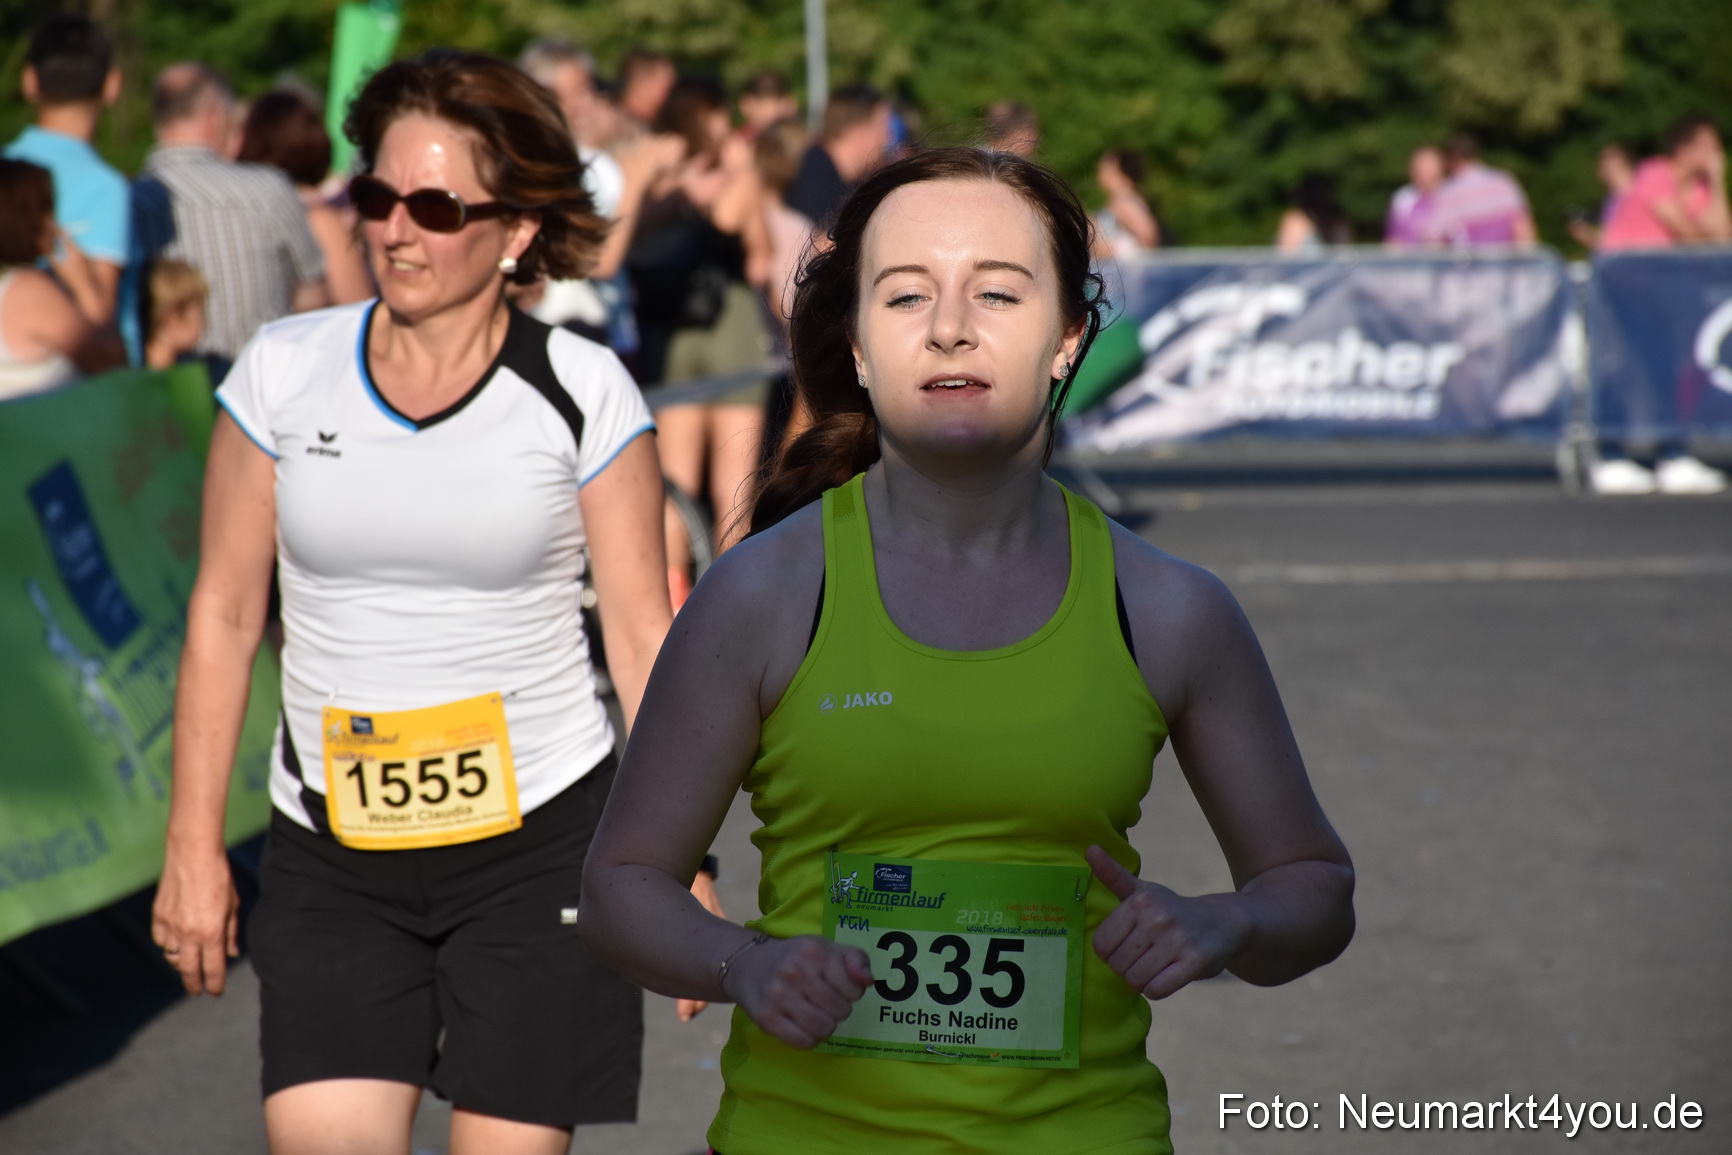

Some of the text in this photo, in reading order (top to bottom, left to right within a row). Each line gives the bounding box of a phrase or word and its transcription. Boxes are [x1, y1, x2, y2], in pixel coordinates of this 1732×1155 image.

[1187, 326, 1466, 390] Fischer
[843, 691, 893, 709] JAKO
[346, 750, 487, 808] 1555
[367, 812, 412, 825] Weber
[417, 805, 473, 822] Claudia
[879, 870, 906, 880] Fischer
[857, 885, 946, 909] firmenlauf
[856, 904, 893, 913] neumarkt
[956, 909, 1003, 926] 2018
[873, 930, 1025, 1008] 335
[879, 1005, 1018, 1031] Fuchs Nadine
[918, 1030, 976, 1045] Burnickl
